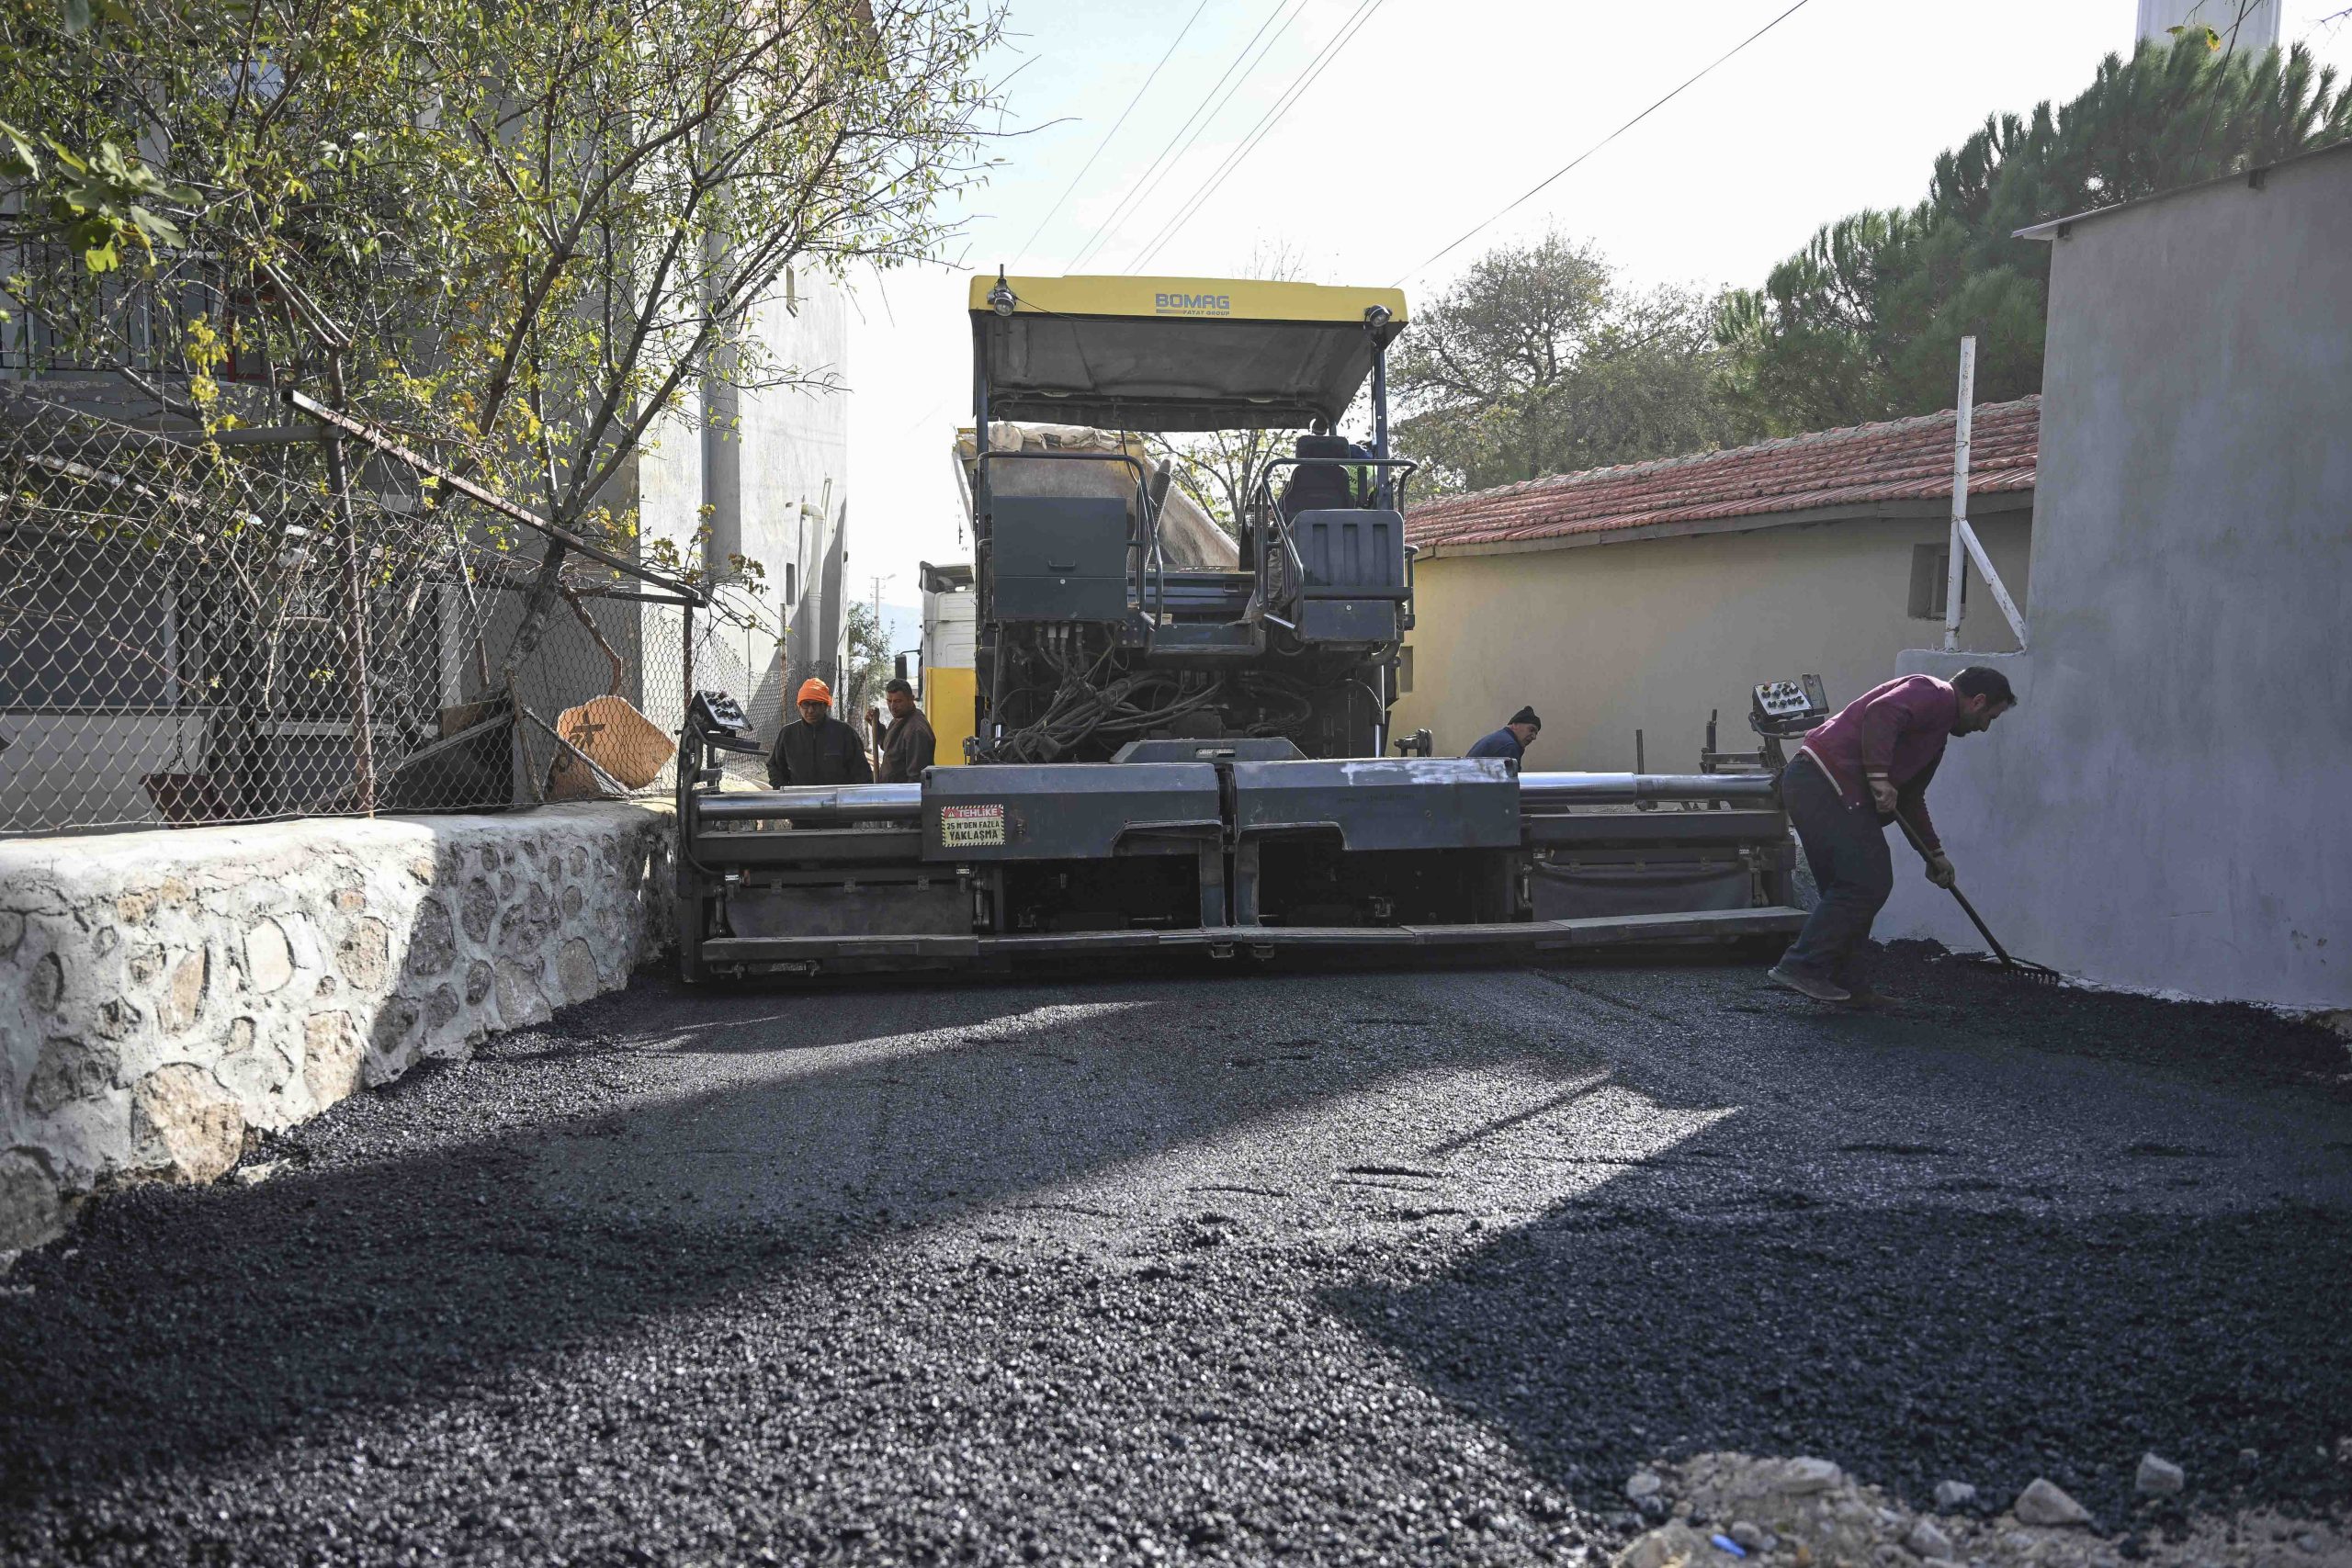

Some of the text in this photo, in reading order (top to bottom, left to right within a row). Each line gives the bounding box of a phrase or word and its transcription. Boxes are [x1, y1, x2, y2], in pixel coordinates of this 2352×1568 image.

[1156, 294, 1230, 309] BOMAG
[979, 820, 1001, 829] FAZLA
[950, 829, 998, 840] YAKLAŞMA
